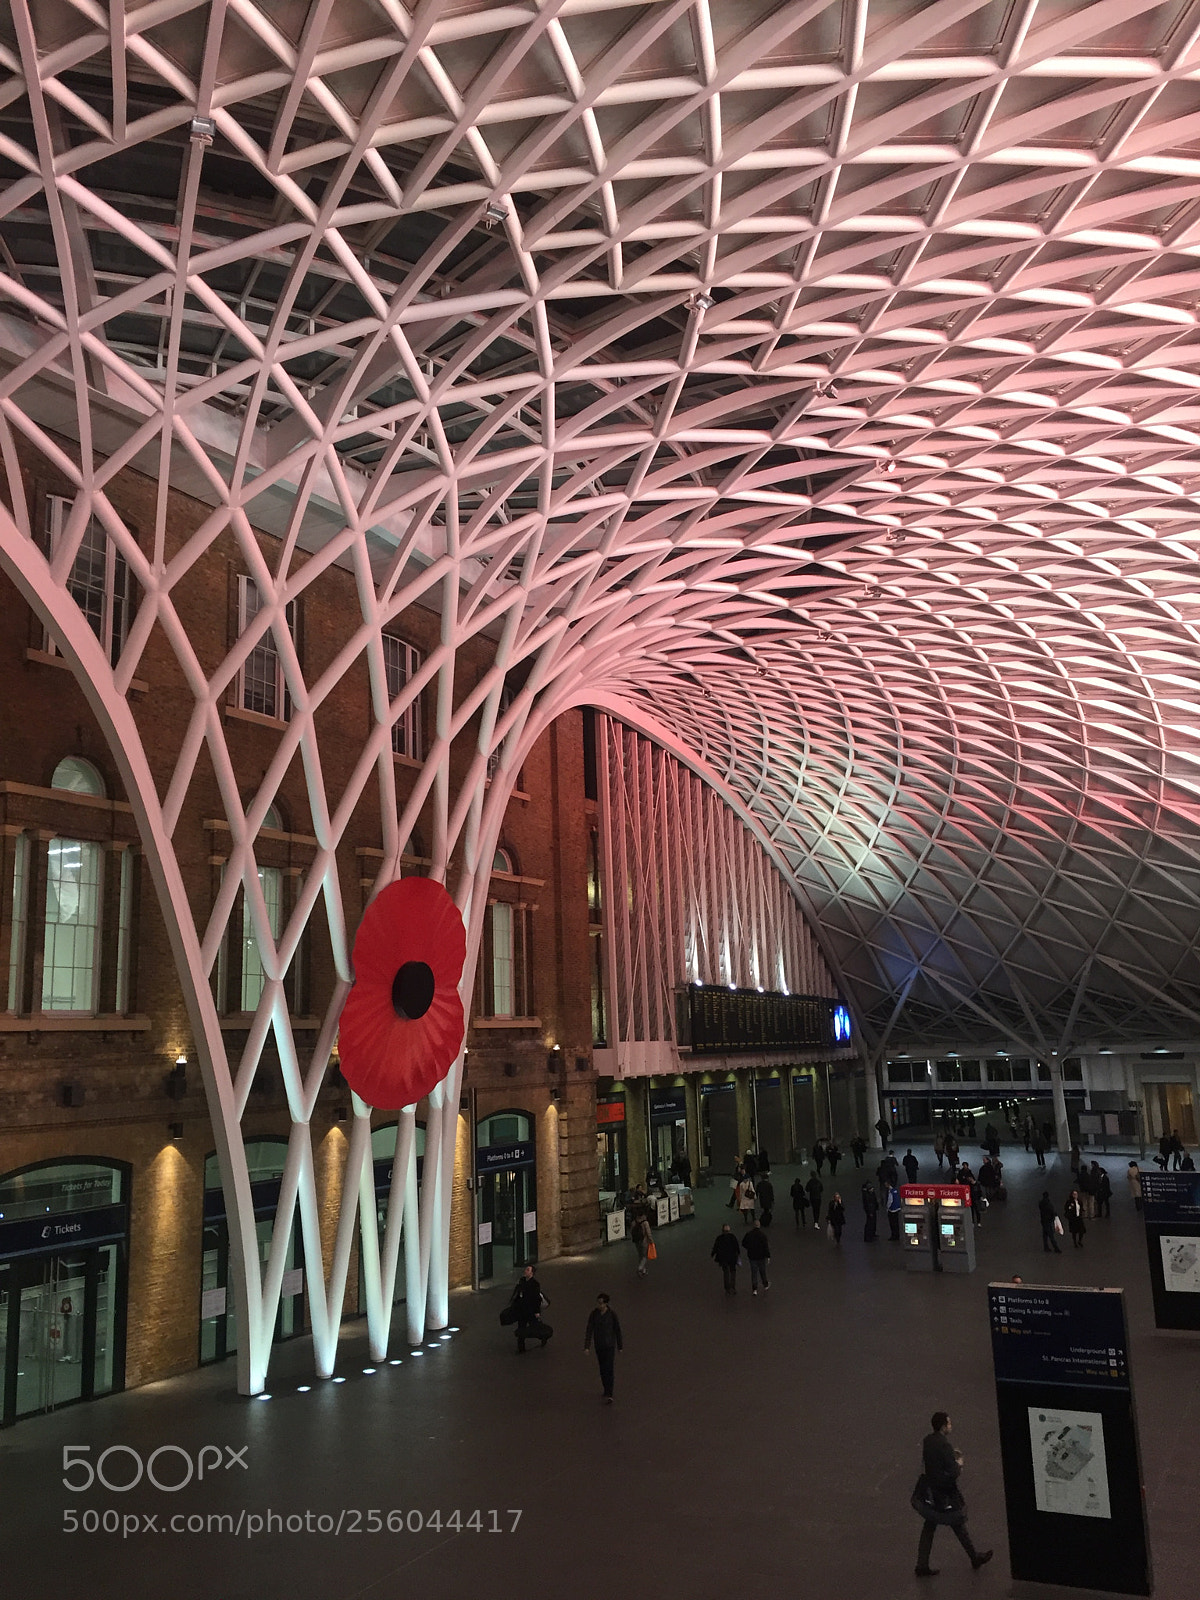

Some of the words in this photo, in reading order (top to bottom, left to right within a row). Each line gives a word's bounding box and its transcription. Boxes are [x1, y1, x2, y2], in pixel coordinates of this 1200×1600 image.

[62, 1183, 83, 1192] Tickets
[83, 1180, 92, 1191] for
[54, 1223, 82, 1235] Tickets
[1008, 1307, 1026, 1315] Dining
[1069, 1346, 1107, 1355] Underground
[1072, 1357, 1108, 1365] International
